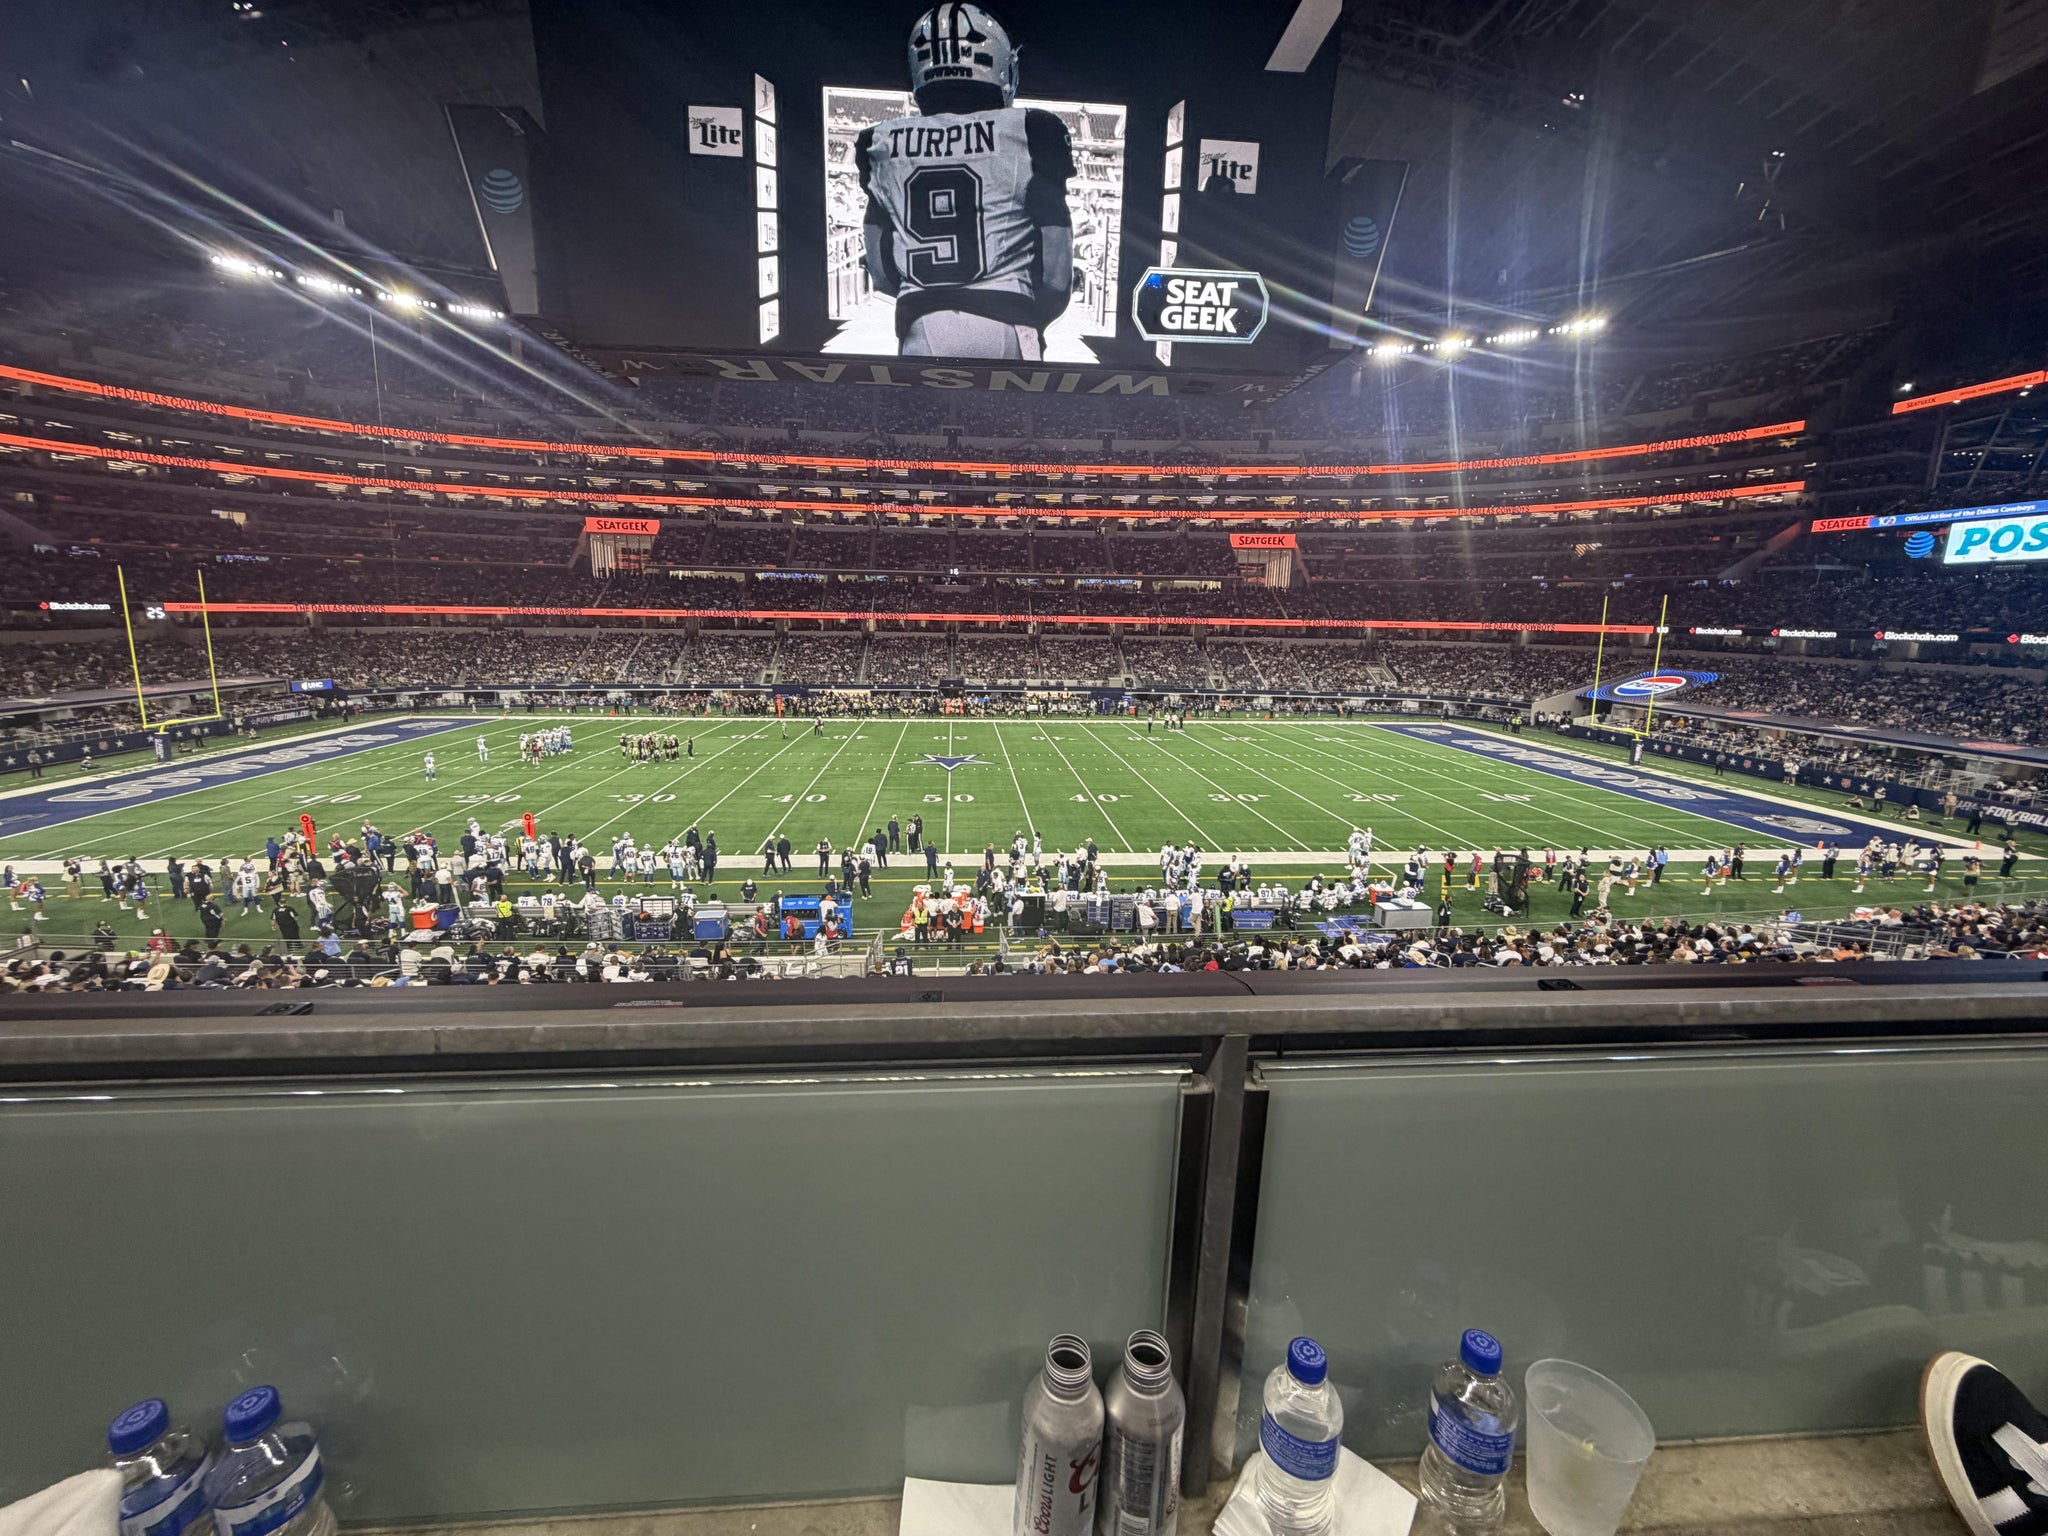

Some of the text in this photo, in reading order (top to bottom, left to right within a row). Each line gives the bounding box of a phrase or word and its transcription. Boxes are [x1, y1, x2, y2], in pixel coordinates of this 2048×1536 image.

[699, 121, 742, 149] Lite
[889, 120, 996, 158] TURPIN
[904, 163, 987, 288] 9
[1165, 279, 1239, 306] SEAT
[1160, 305, 1239, 333] GEEK
[705, 358, 1170, 397] WINSTAR
[124, 389, 167, 406] DALLAS
[170, 397, 227, 415] COWBOYS
[369, 426, 402, 437] DALLAS
[405, 430, 449, 442] COWBOYS
[1904, 513, 1929, 522] Official
[1930, 510, 1953, 520] Airline
[1976, 506, 1999, 516] Dallas
[2000, 504, 2036, 514] Cowboys
[596, 519, 649, 533] SEATGEEK
[1238, 535, 1285, 546] SEATGEEK
[1954, 521, 2048, 556] POS
[50, 602, 110, 610] Blockchain.com
[1695, 627, 1742, 635] Blockchain.com
[1779, 629, 1837, 638] Blockchain.com
[1884, 631, 1959, 643] Blockchain.com
[2020, 634, 2048, 644] Bloc
[771, 793, 828, 802] 40
[922, 793, 975, 802] 50
[1069, 793, 1119, 802] 40
[1207, 793, 1260, 802] 30
[1042, 1453, 1057, 1495] LIGHT
